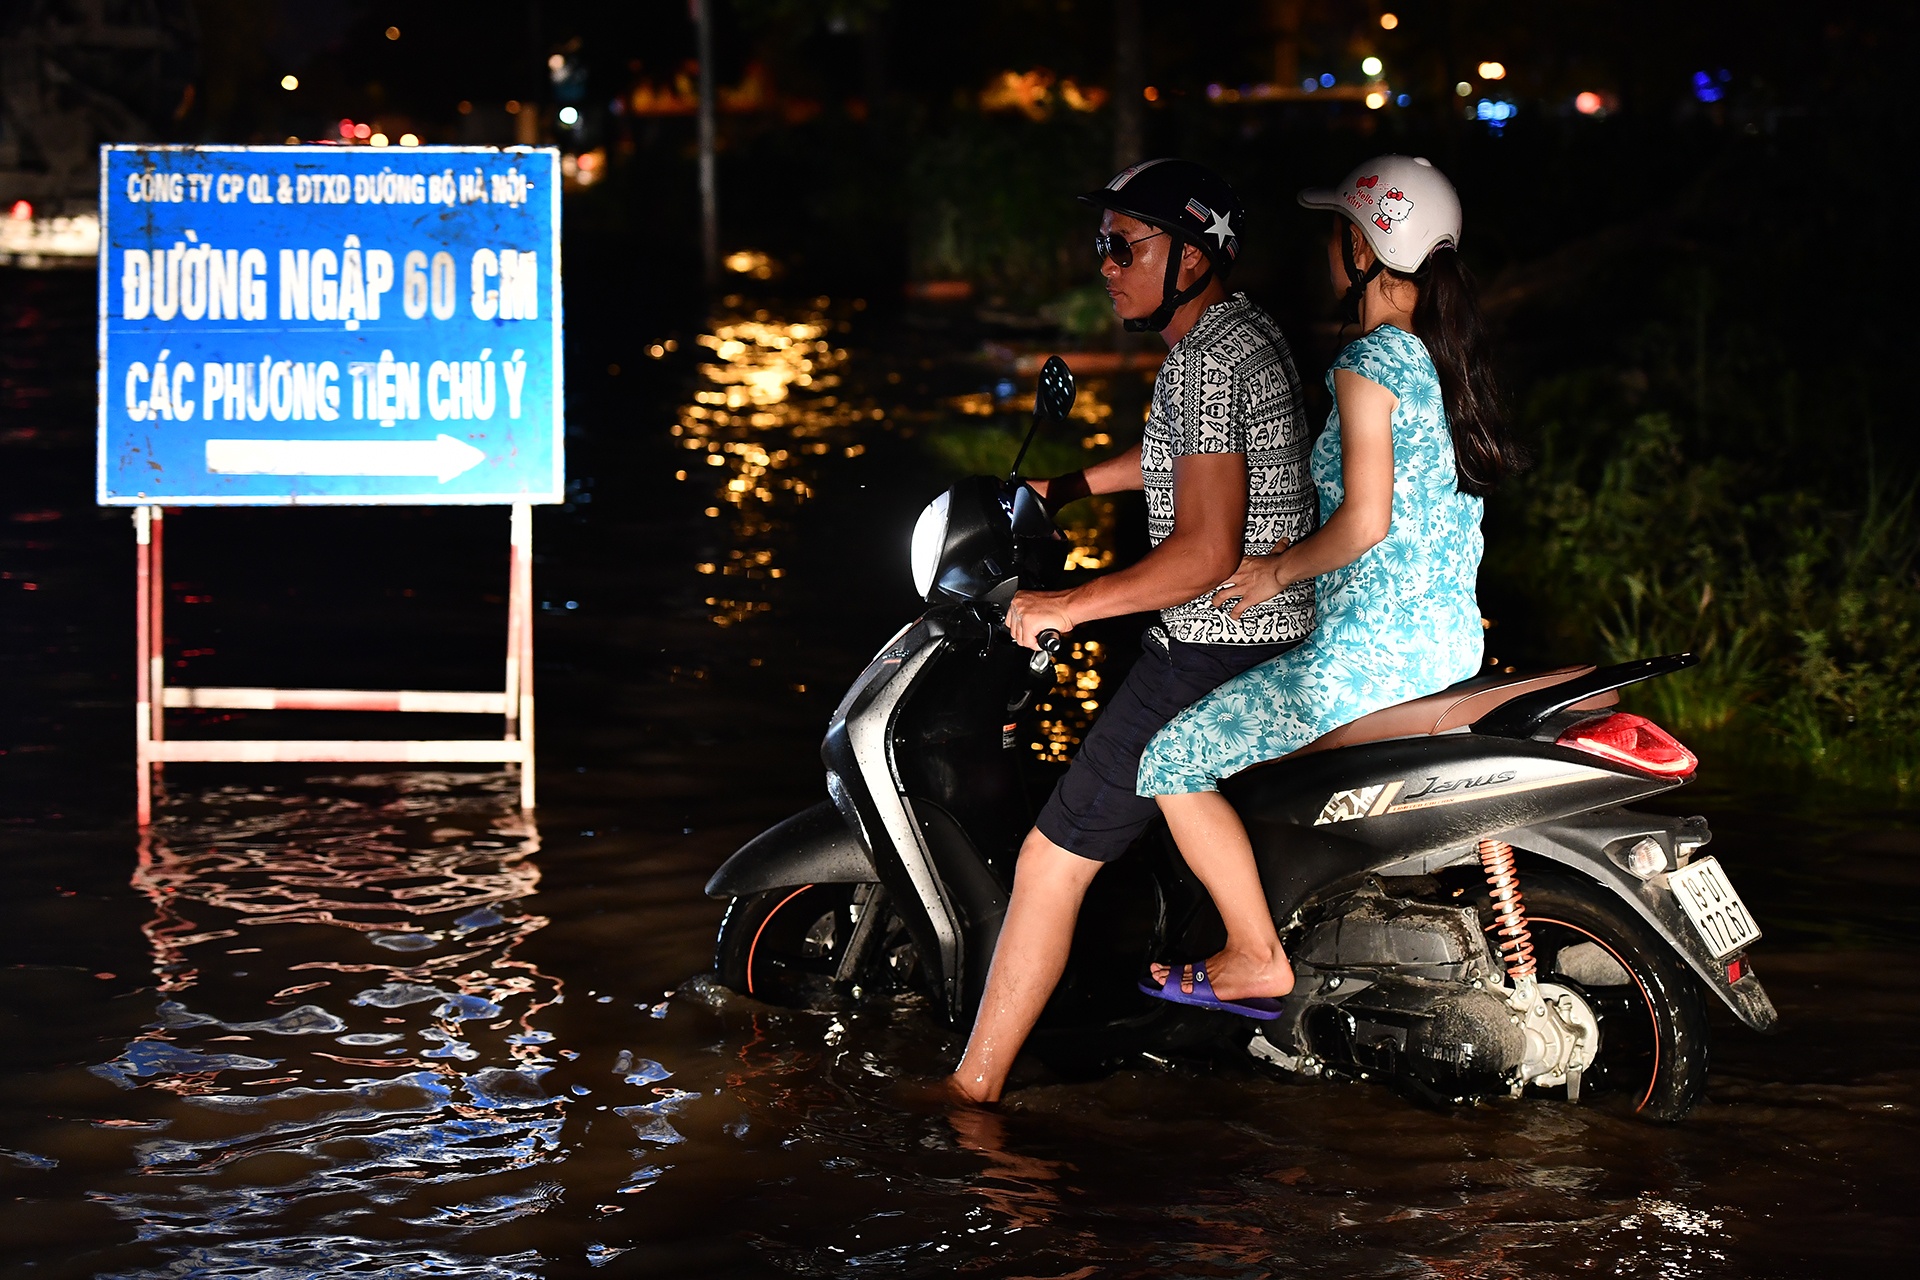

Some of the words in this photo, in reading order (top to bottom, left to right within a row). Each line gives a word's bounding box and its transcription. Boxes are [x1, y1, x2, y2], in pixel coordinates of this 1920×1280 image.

[186, 173, 214, 203] TY
[217, 173, 244, 204] CP
[247, 174, 274, 204] QL
[277, 174, 294, 205] &
[354, 166, 425, 204] ĐƯỜNG
[428, 168, 457, 208] BỘ
[459, 167, 489, 204] HÀ
[491, 167, 527, 208] NỘI
[1346, 194, 1363, 210] Kitty
[1356, 189, 1374, 206] Hello
[122, 229, 267, 321] ĐƯỜNG
[279, 234, 394, 331] NGẬP
[403, 250, 456, 321] 60
[471, 248, 538, 321] CM
[125, 349, 195, 422] CÁC
[203, 355, 340, 422] PHƯƠNG
[348, 349, 420, 428] TIỆN
[427, 347, 496, 421] CHÚ
[502, 348, 527, 420] Ý
[1404, 770, 1518, 800] Janus
[1700, 900, 1753, 952] 172.67
